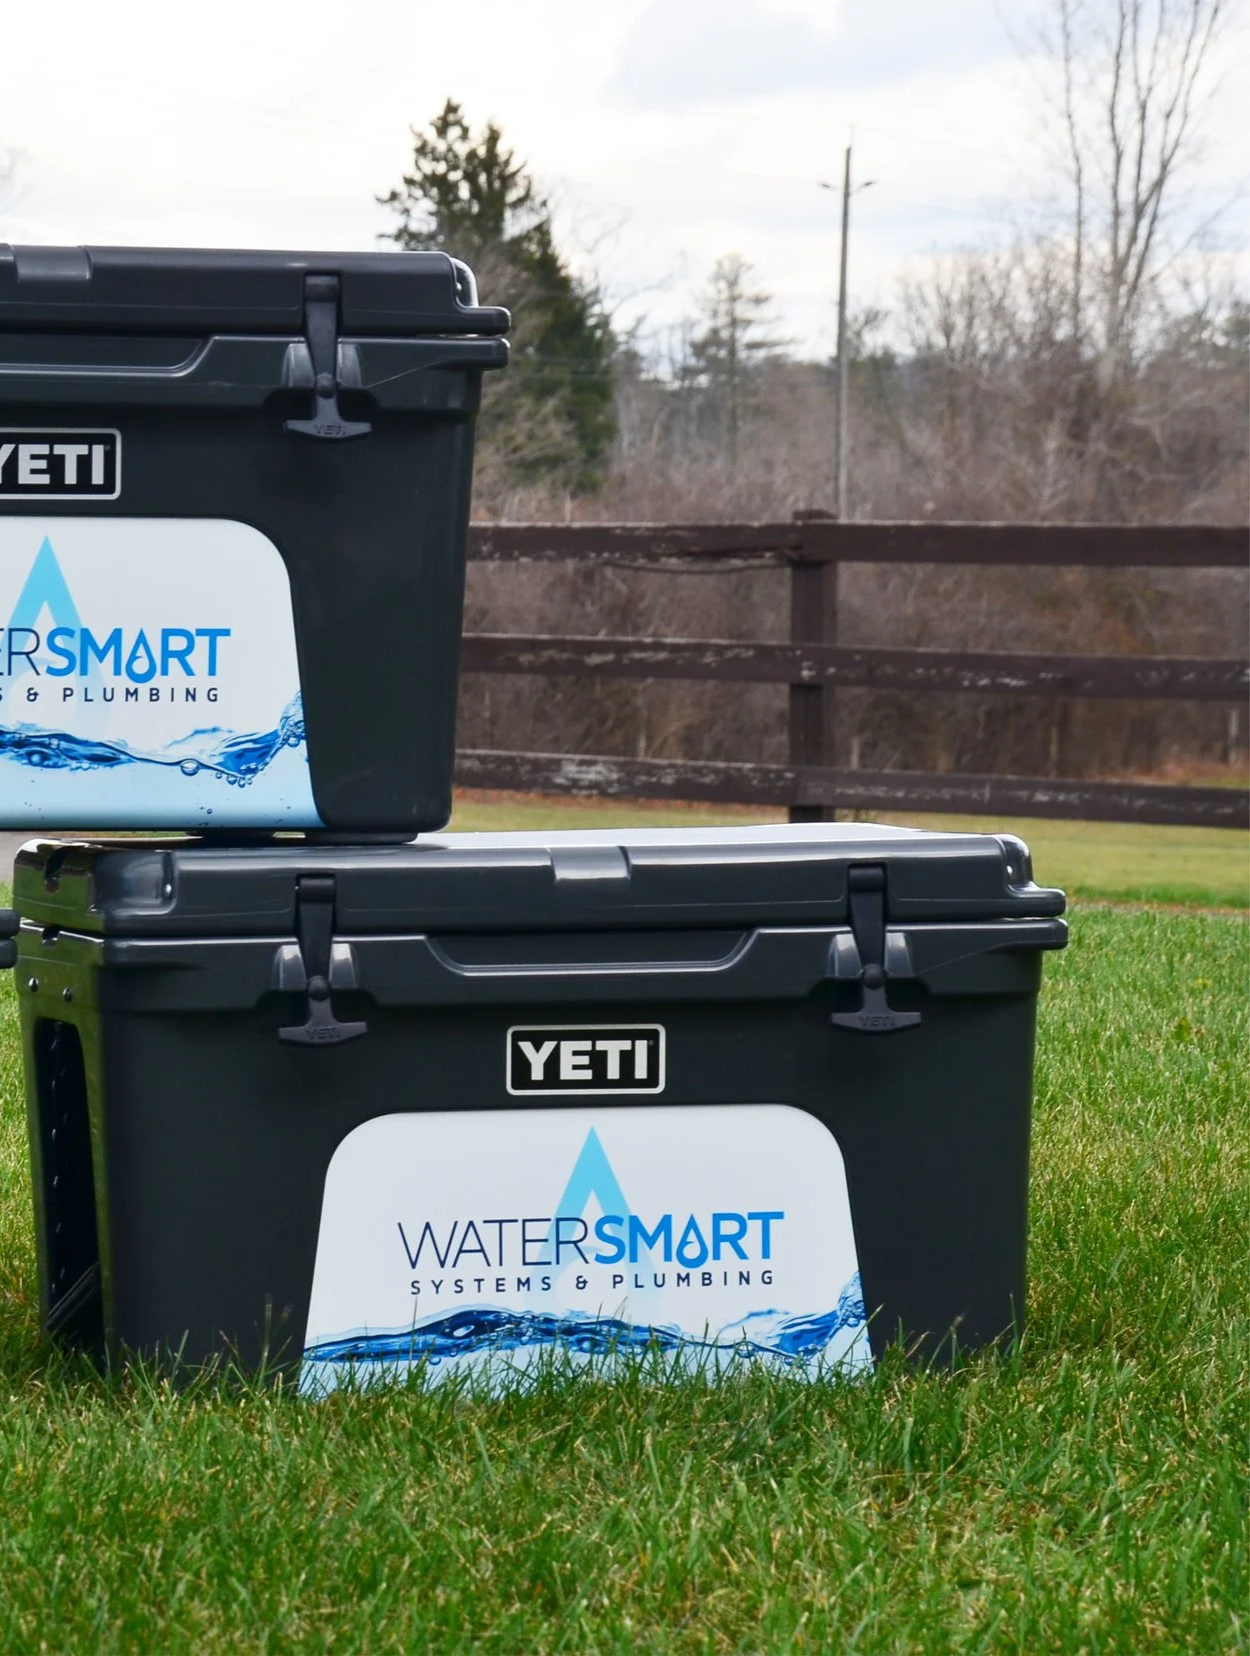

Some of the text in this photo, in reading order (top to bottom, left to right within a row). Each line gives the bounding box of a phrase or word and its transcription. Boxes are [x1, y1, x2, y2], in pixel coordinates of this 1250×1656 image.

[26, 686, 40, 703] &
[62, 686, 218, 703] PLUMBING
[517, 1039, 648, 1081] YETI
[410, 1269, 773, 1296] SYSTEMS & PLUMBING
